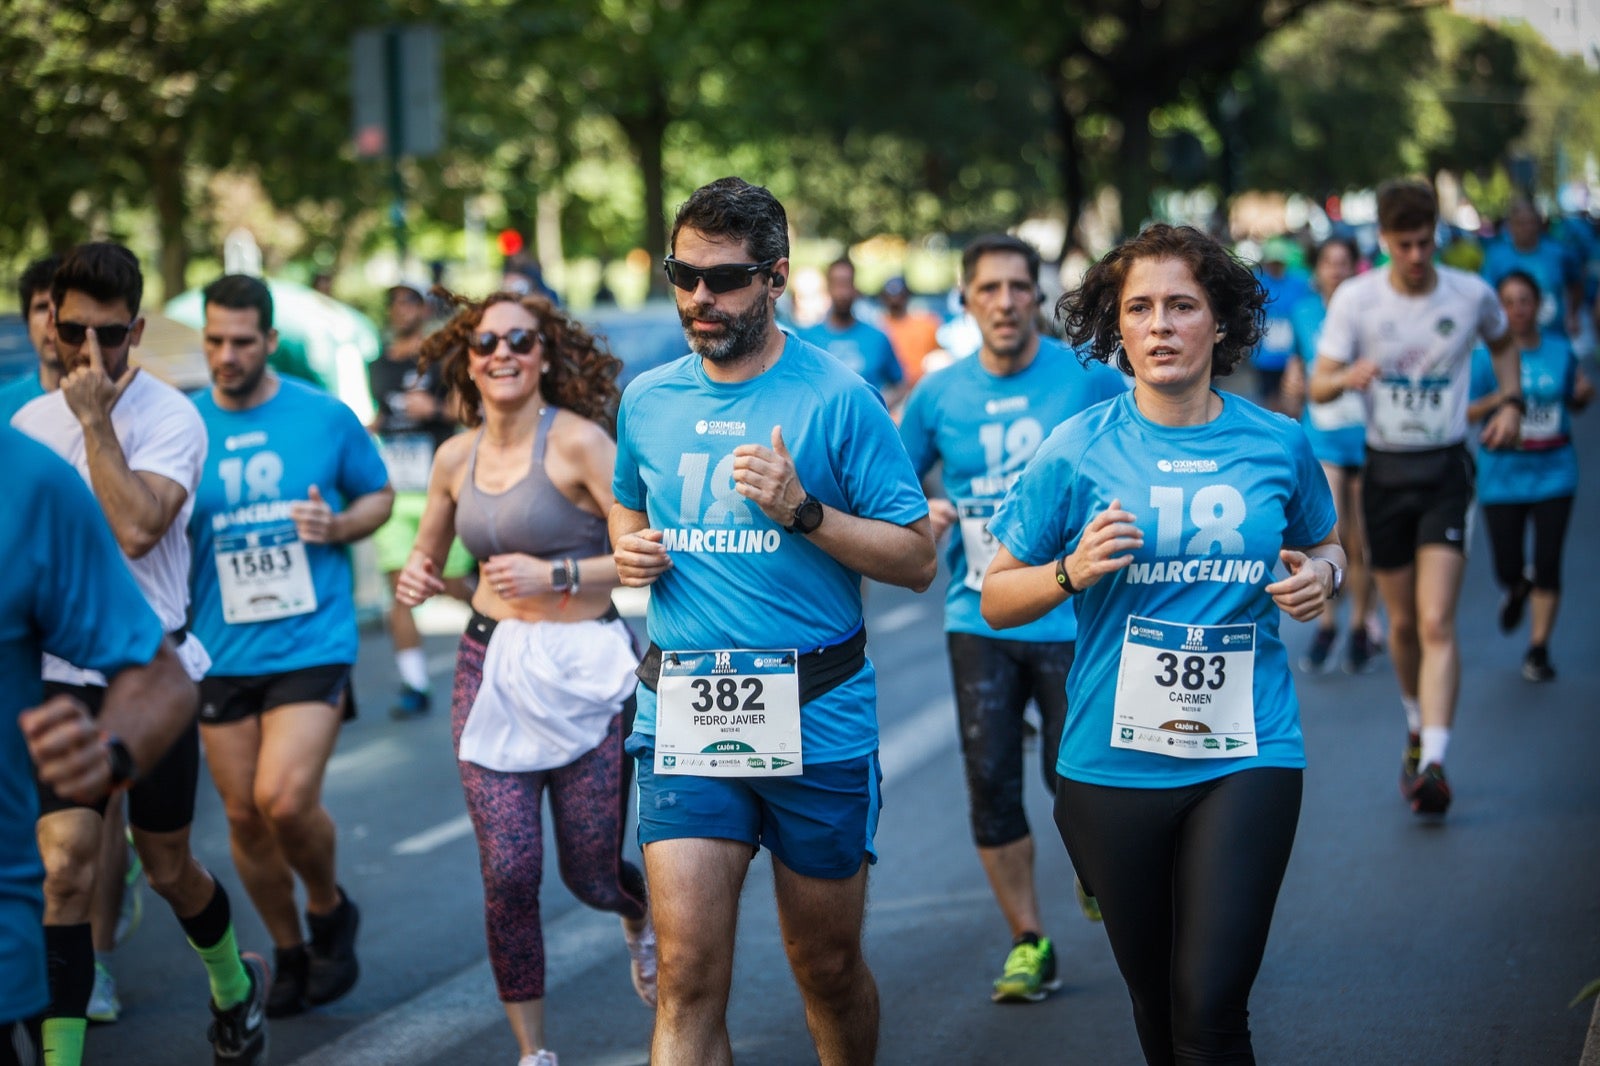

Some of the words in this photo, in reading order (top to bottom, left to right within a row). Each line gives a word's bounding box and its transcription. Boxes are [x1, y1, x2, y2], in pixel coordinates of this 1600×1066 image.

[709, 421, 746, 430] OXIMESA
[1172, 459, 1218, 468] OXIMESA
[219, 451, 284, 506] 18
[677, 453, 754, 525] 18
[1149, 484, 1247, 557] 18
[662, 528, 781, 553] MARCELINO
[231, 547, 292, 576] 1583
[1126, 559, 1265, 584] MARCELINO
[1186, 627, 1205, 641] 18
[1154, 652, 1226, 690] 383
[691, 677, 765, 712] 382
[1169, 691, 1212, 704] CARMEN
[694, 715, 728, 725] PEDRO
[731, 714, 766, 725] JAVIER
